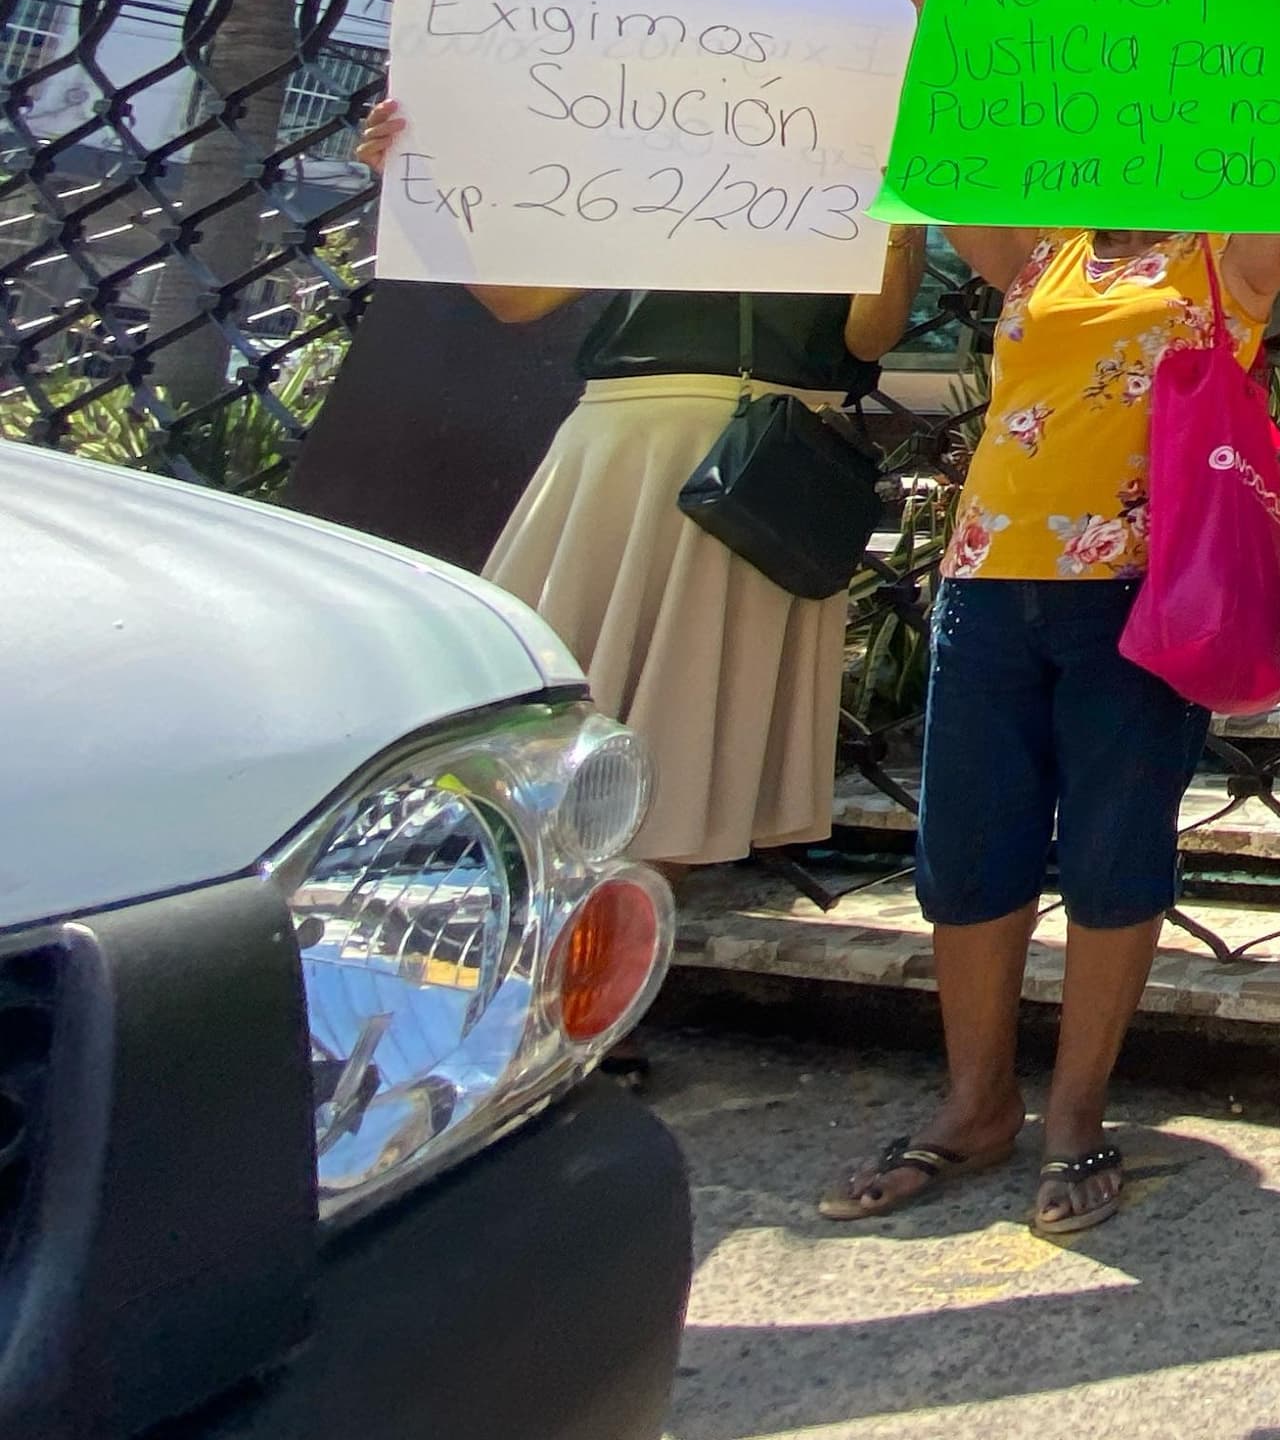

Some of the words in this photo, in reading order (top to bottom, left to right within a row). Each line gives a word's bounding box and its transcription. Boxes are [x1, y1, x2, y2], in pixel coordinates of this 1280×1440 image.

[920, 15, 1139, 87] Justicia
[1170, 39, 1265, 95] para
[528, 62, 818, 151] Solución
[1116, 96, 1201, 144] que
[514, 163, 860, 241] 262/2013
[1021, 155, 1103, 200] para
[1122, 152, 1162, 190] el
